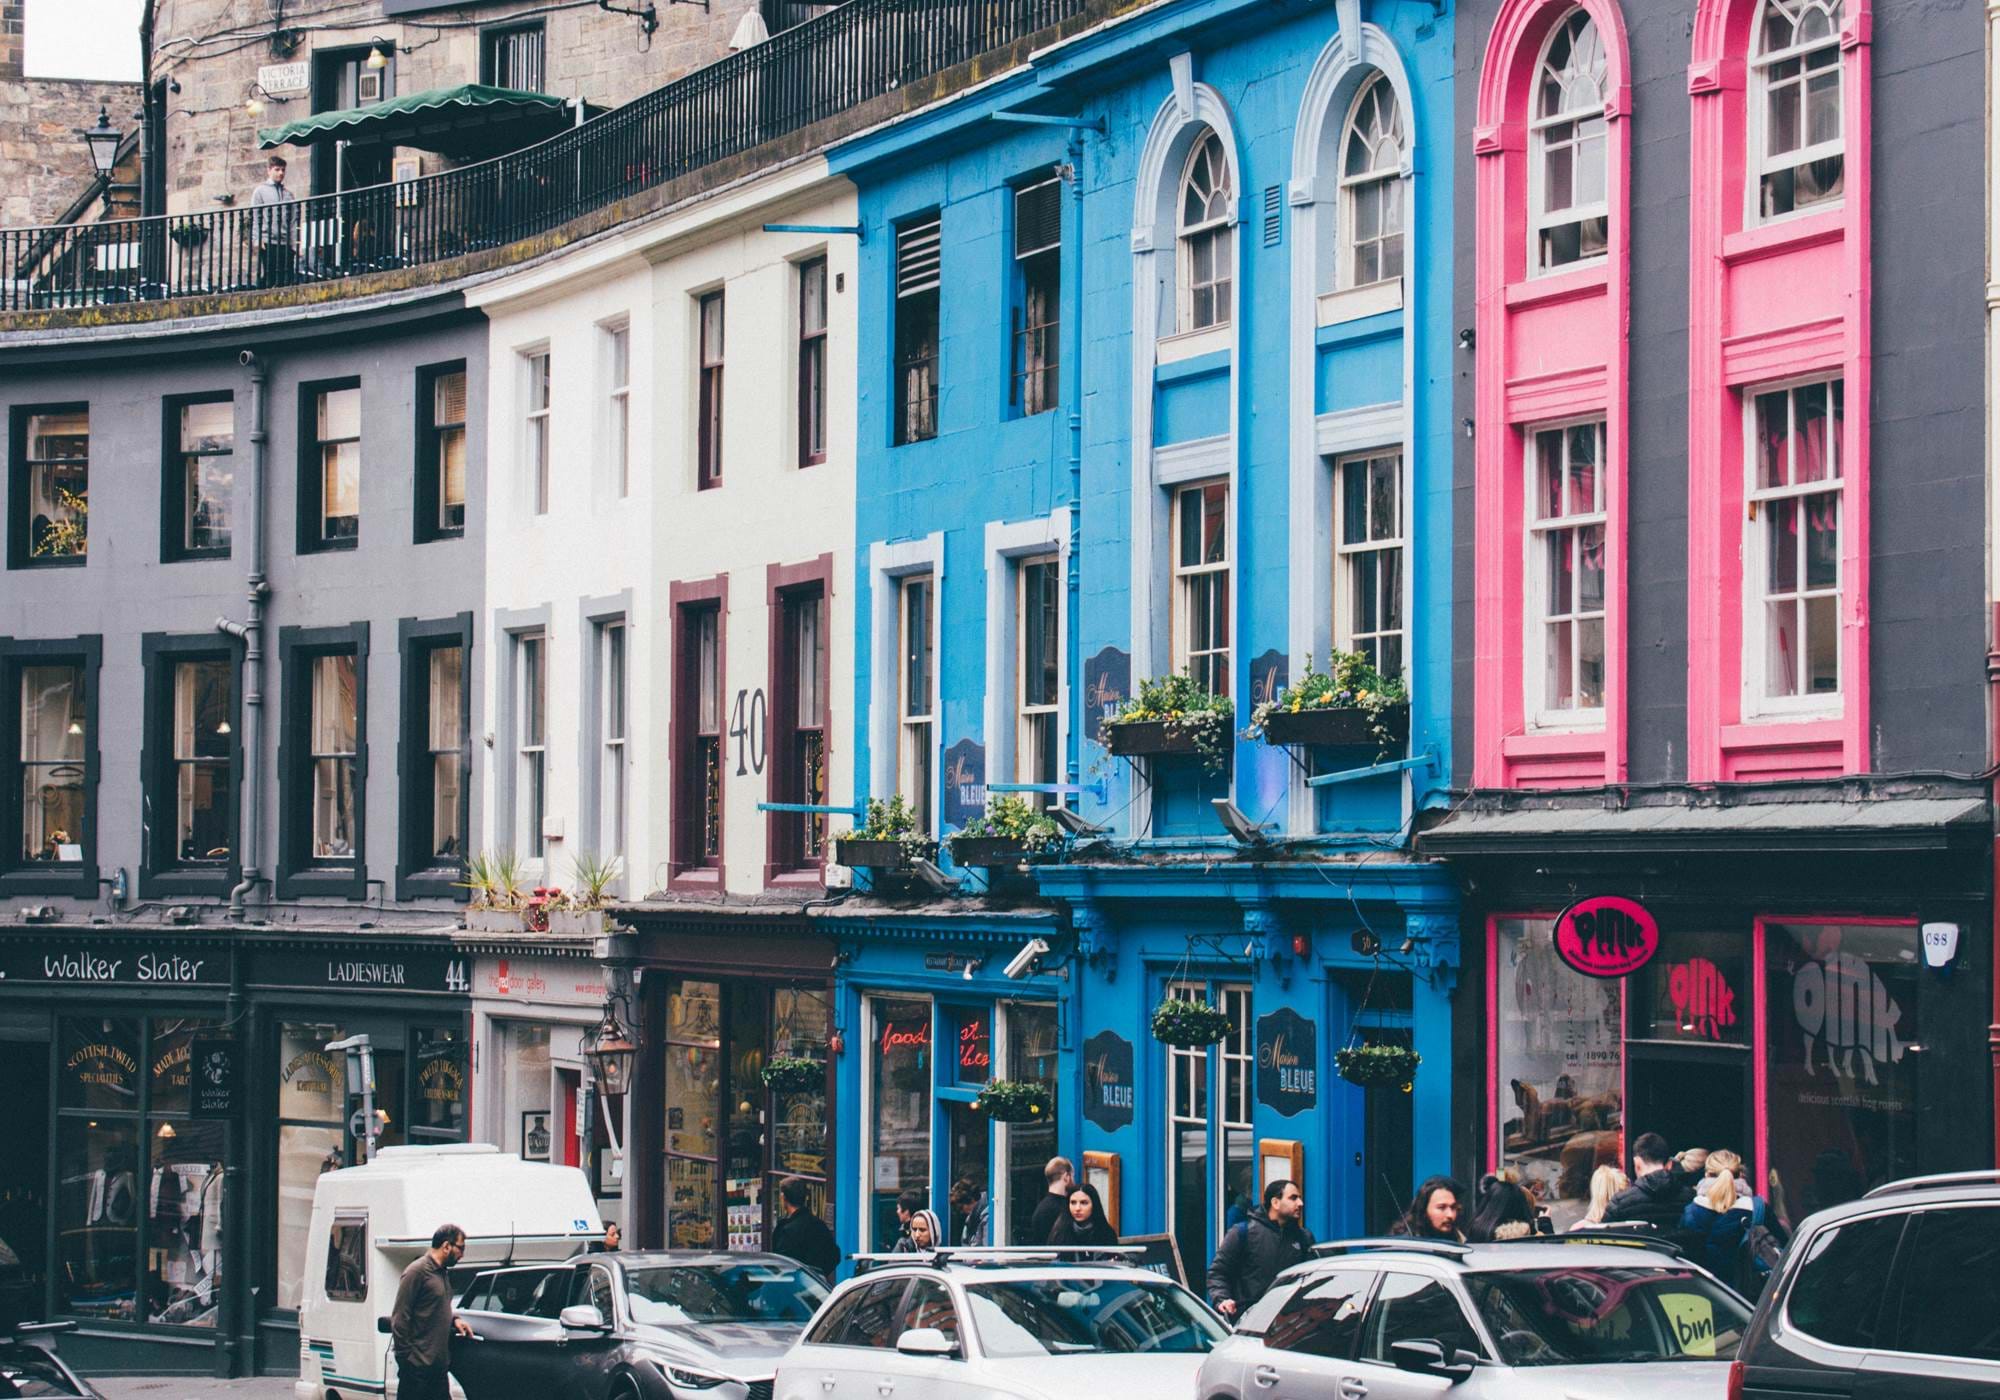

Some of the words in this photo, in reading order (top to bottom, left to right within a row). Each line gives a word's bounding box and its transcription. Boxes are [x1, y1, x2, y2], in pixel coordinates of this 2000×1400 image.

[262, 64, 304, 79] VICTORIA
[263, 77, 303, 90] TERRACE
[730, 688, 766, 775] 40
[1925, 932, 1948, 946] CSS
[44, 952, 122, 980] Walker
[137, 952, 204, 981] Slater
[328, 962, 405, 984] LADIESWEAR
[1668, 957, 1736, 1030] oink
[1793, 951, 1903, 1072] oink
[67, 1045, 107, 1069] SCOTTISH
[111, 1046, 137, 1073] TWEED
[1258, 1032, 1298, 1072] Maison
[201, 1089, 230, 1097] Walker
[1280, 1067, 1315, 1094] BLEUE
[201, 1099, 229, 1109] Slater
[1103, 1084, 1132, 1108] BLEUE
[1676, 1308, 1712, 1345] bin
